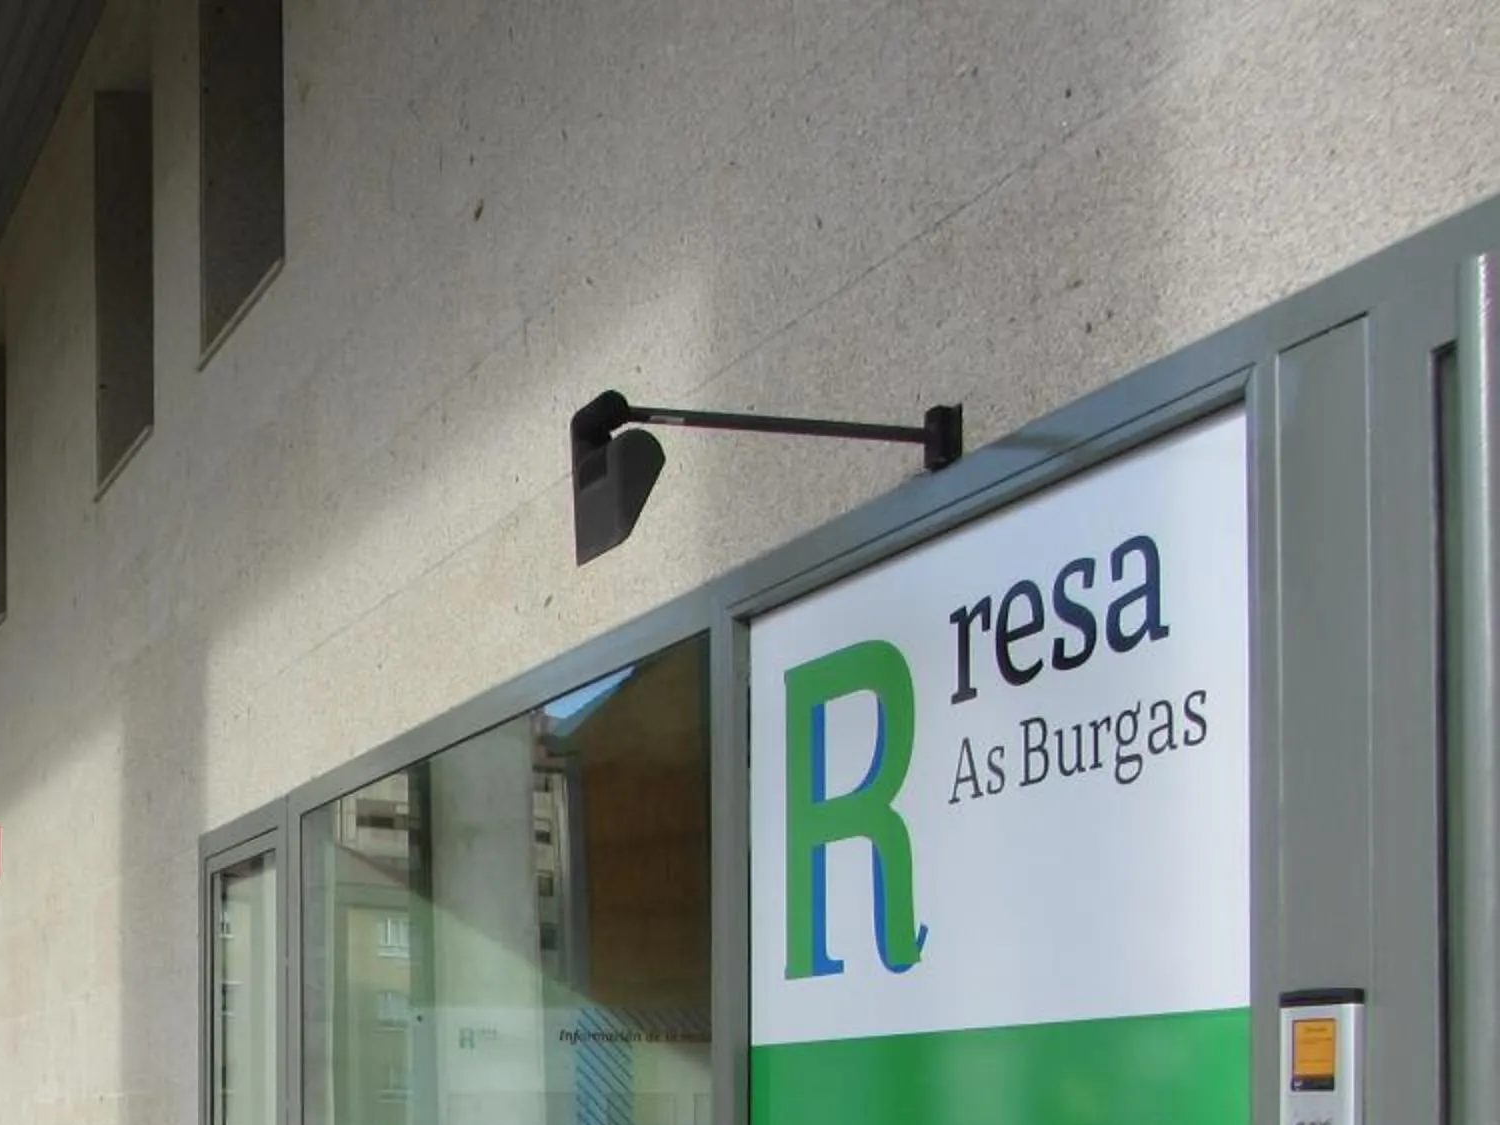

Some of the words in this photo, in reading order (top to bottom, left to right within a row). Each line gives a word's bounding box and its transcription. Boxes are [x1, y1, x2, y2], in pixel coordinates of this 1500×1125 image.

[949, 535, 1170, 704] resa
[949, 737, 1006, 804] As
[1019, 689, 1208, 785] Burgas
